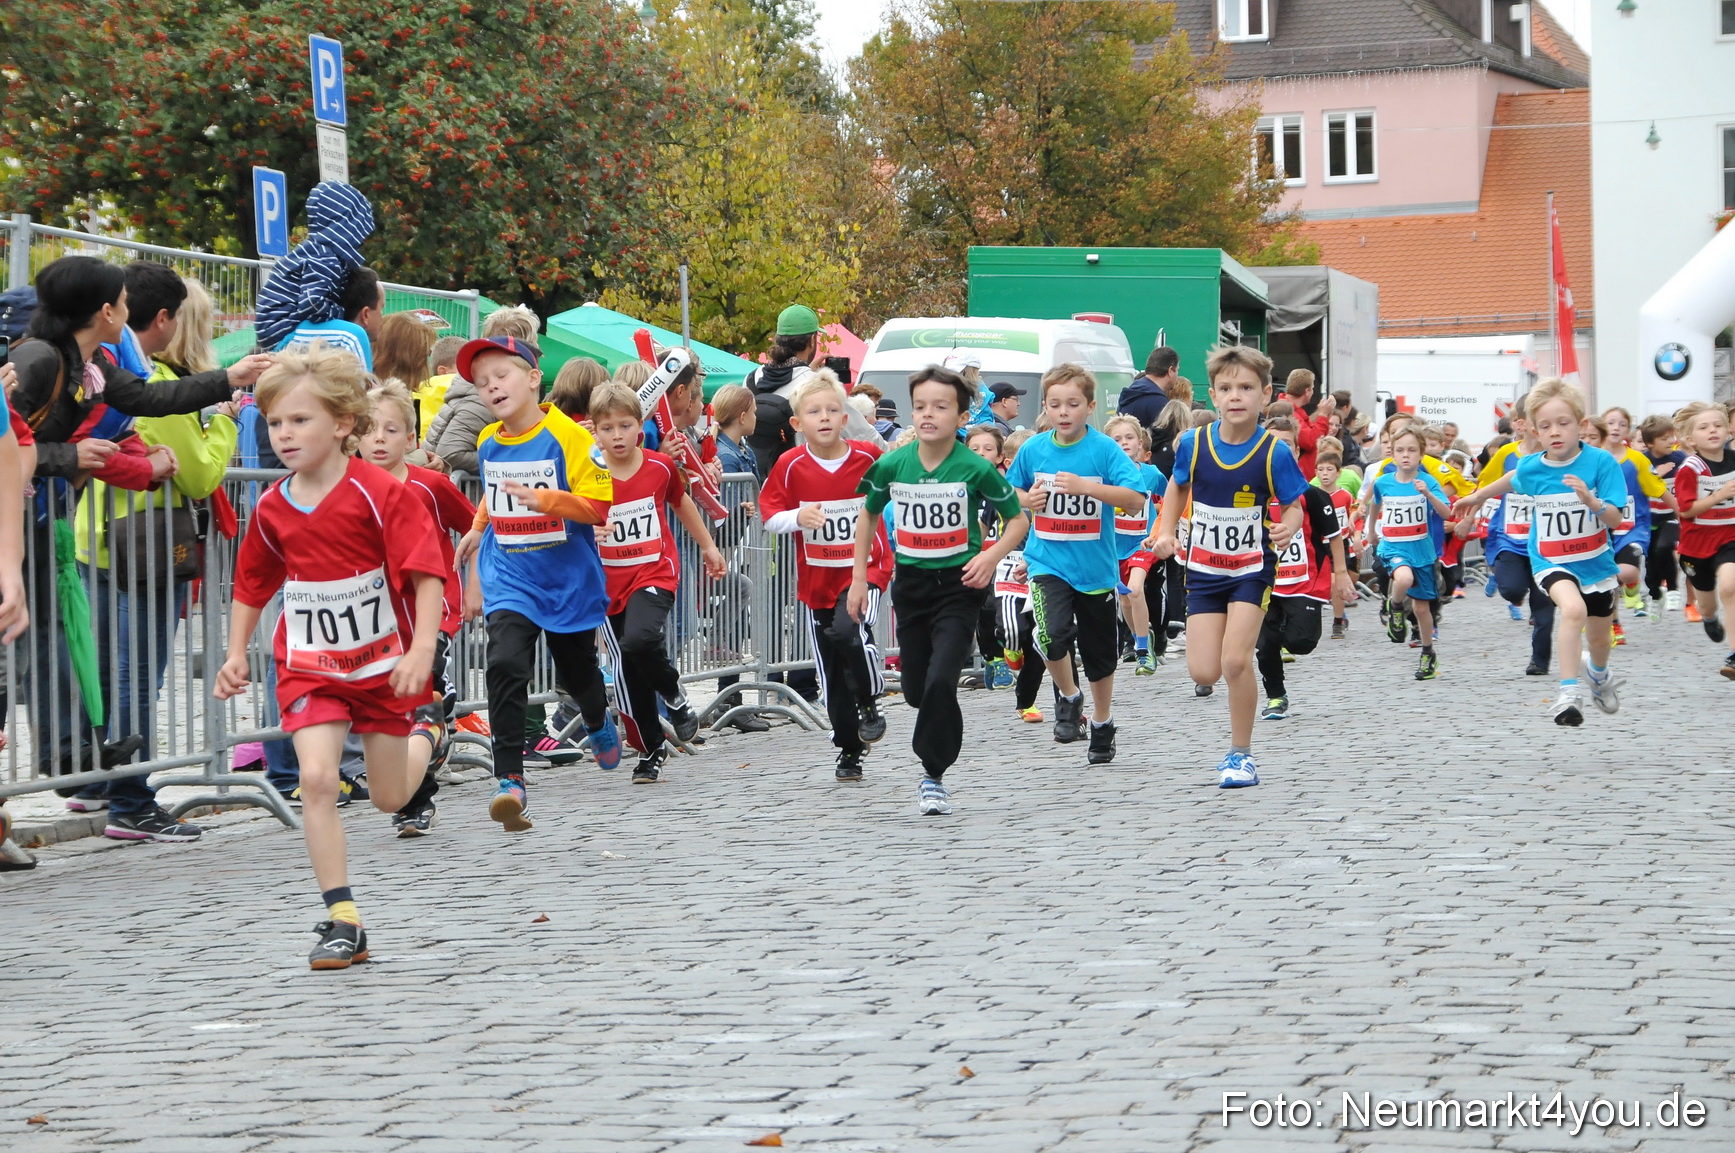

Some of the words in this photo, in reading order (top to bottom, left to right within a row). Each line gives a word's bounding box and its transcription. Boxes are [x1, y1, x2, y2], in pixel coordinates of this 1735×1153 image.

[317, 48, 336, 111] P
[261, 180, 280, 245] P
[639, 375, 666, 402] bmw
[1421, 395, 1478, 404] Bayerisches
[1421, 406, 1447, 414] Rotes
[502, 470, 541, 479] Neumarkt
[892, 488, 913, 499] PARTL
[914, 491, 954, 499] Neumarkt
[824, 505, 859, 515] Neumarkt
[1536, 501, 1557, 509] PARTL
[612, 506, 646, 518] Neumarkt
[897, 501, 962, 529] 7088
[1386, 506, 1424, 525] 7510
[1212, 514, 1250, 522] Neumarkt
[496, 520, 548, 532] Alexander
[1050, 521, 1080, 532] Julian
[913, 536, 946, 547] Marco
[1196, 521, 1256, 552] 7184
[616, 547, 644, 558] Lukas
[822, 547, 852, 558] Simon
[1562, 543, 1588, 553] Leon
[1209, 555, 1240, 568] Niklas
[286, 592, 316, 603] PARTL
[316, 584, 370, 603] Neumarkt
[294, 595, 382, 645] 7017
[317, 646, 375, 674] Raphael
